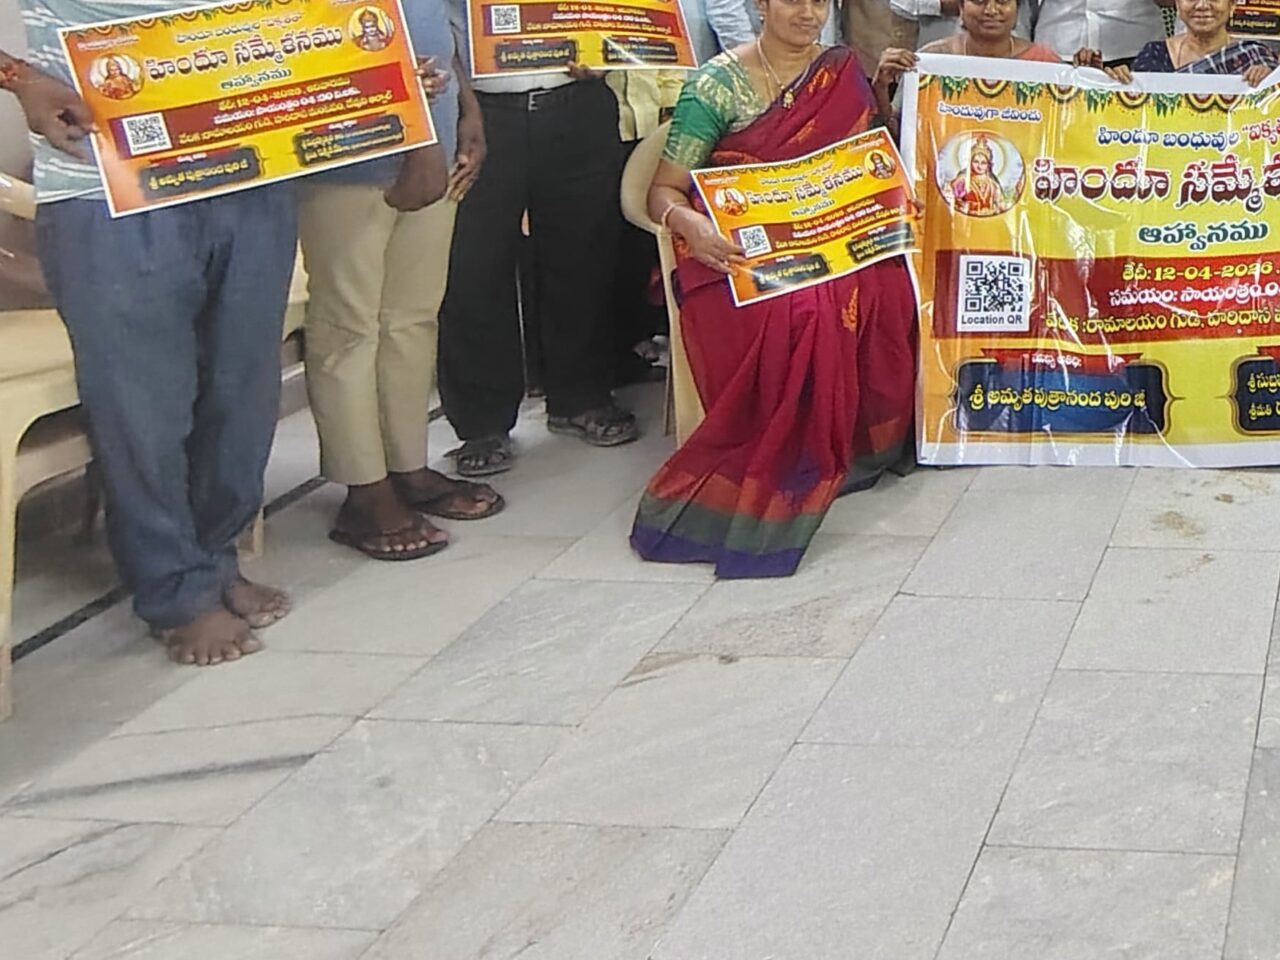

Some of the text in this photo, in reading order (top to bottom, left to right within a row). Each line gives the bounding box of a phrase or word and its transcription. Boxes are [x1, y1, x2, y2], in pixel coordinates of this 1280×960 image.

[1098, 127, 1158, 145] హిందూ
[1163, 130, 1239, 151] బంధువుల
[1033, 157, 1171, 206] హిందూ
[1138, 220, 1268, 252] ఆహ్వానము
[961, 314, 1023, 326] Location QR
[968, 385, 985, 410] శ్రీ
